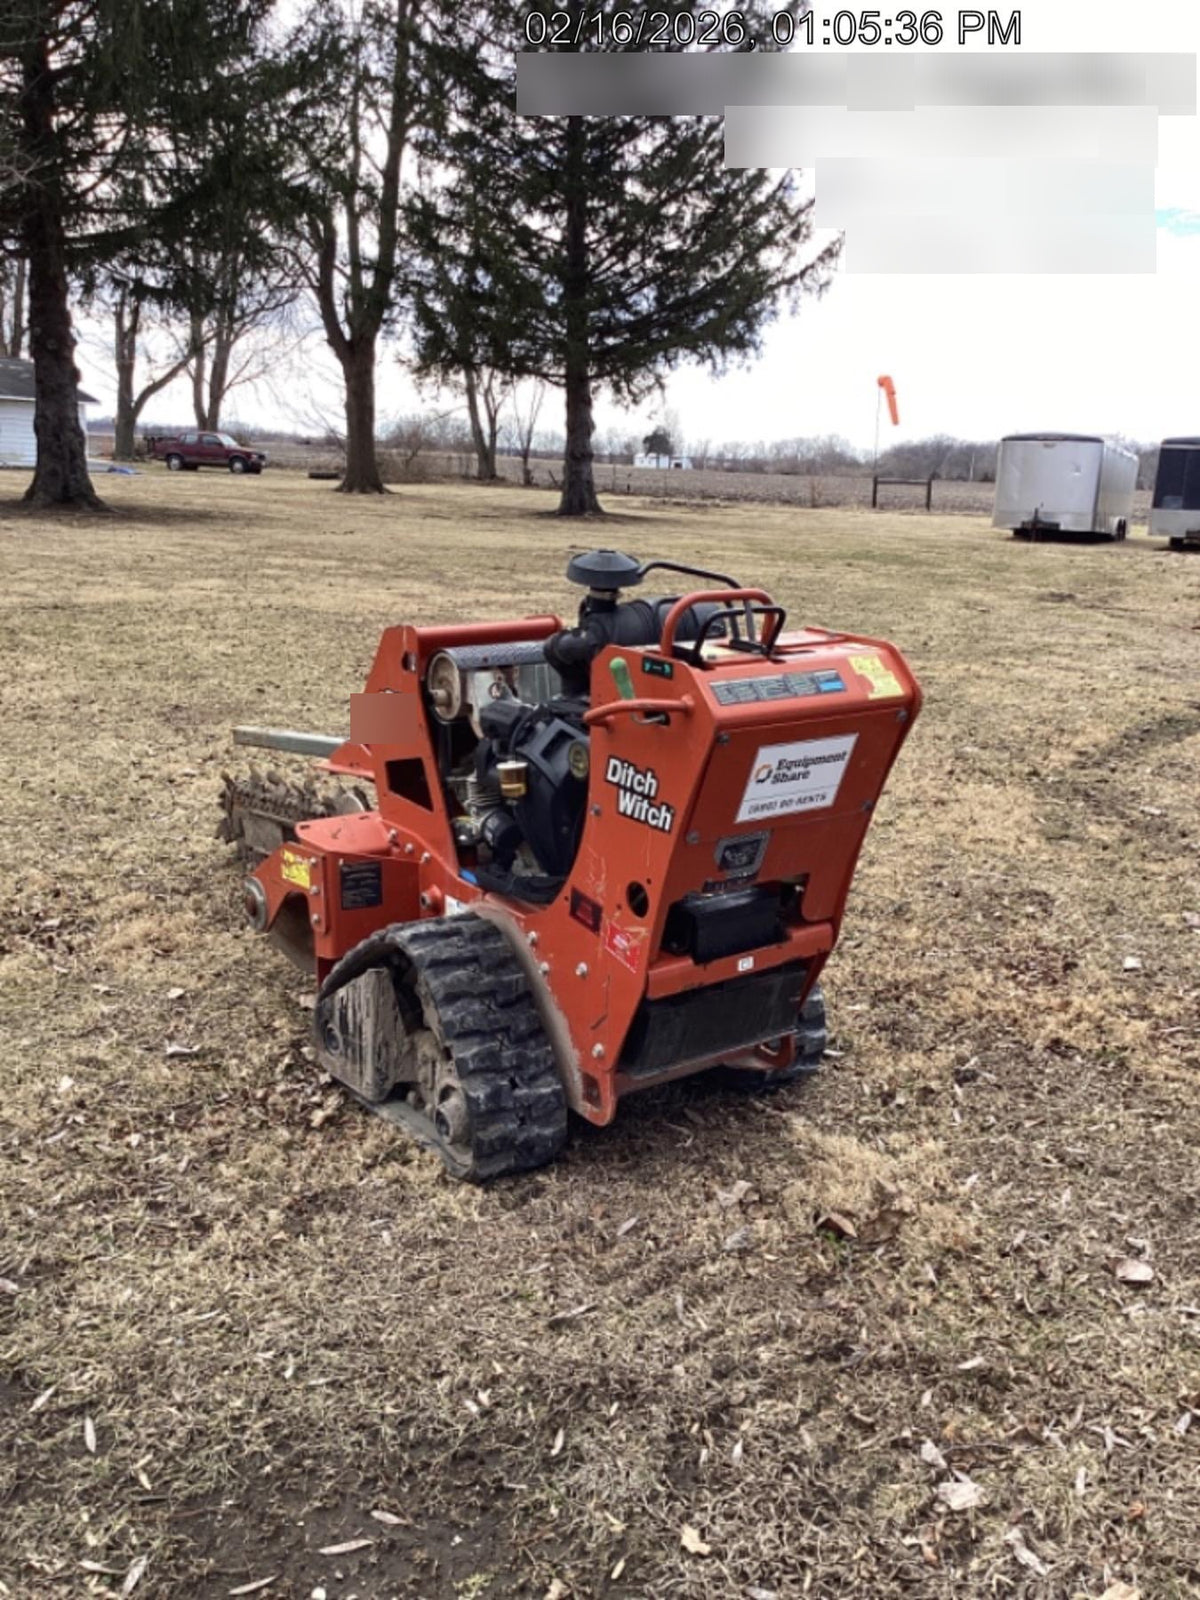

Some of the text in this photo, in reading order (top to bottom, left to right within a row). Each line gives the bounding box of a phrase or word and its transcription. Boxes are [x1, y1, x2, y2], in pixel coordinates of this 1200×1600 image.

[776, 751, 847, 772] Equipment
[606, 757, 658, 797] Ditch
[771, 769, 810, 785] Share
[617, 789, 673, 832] Witch
